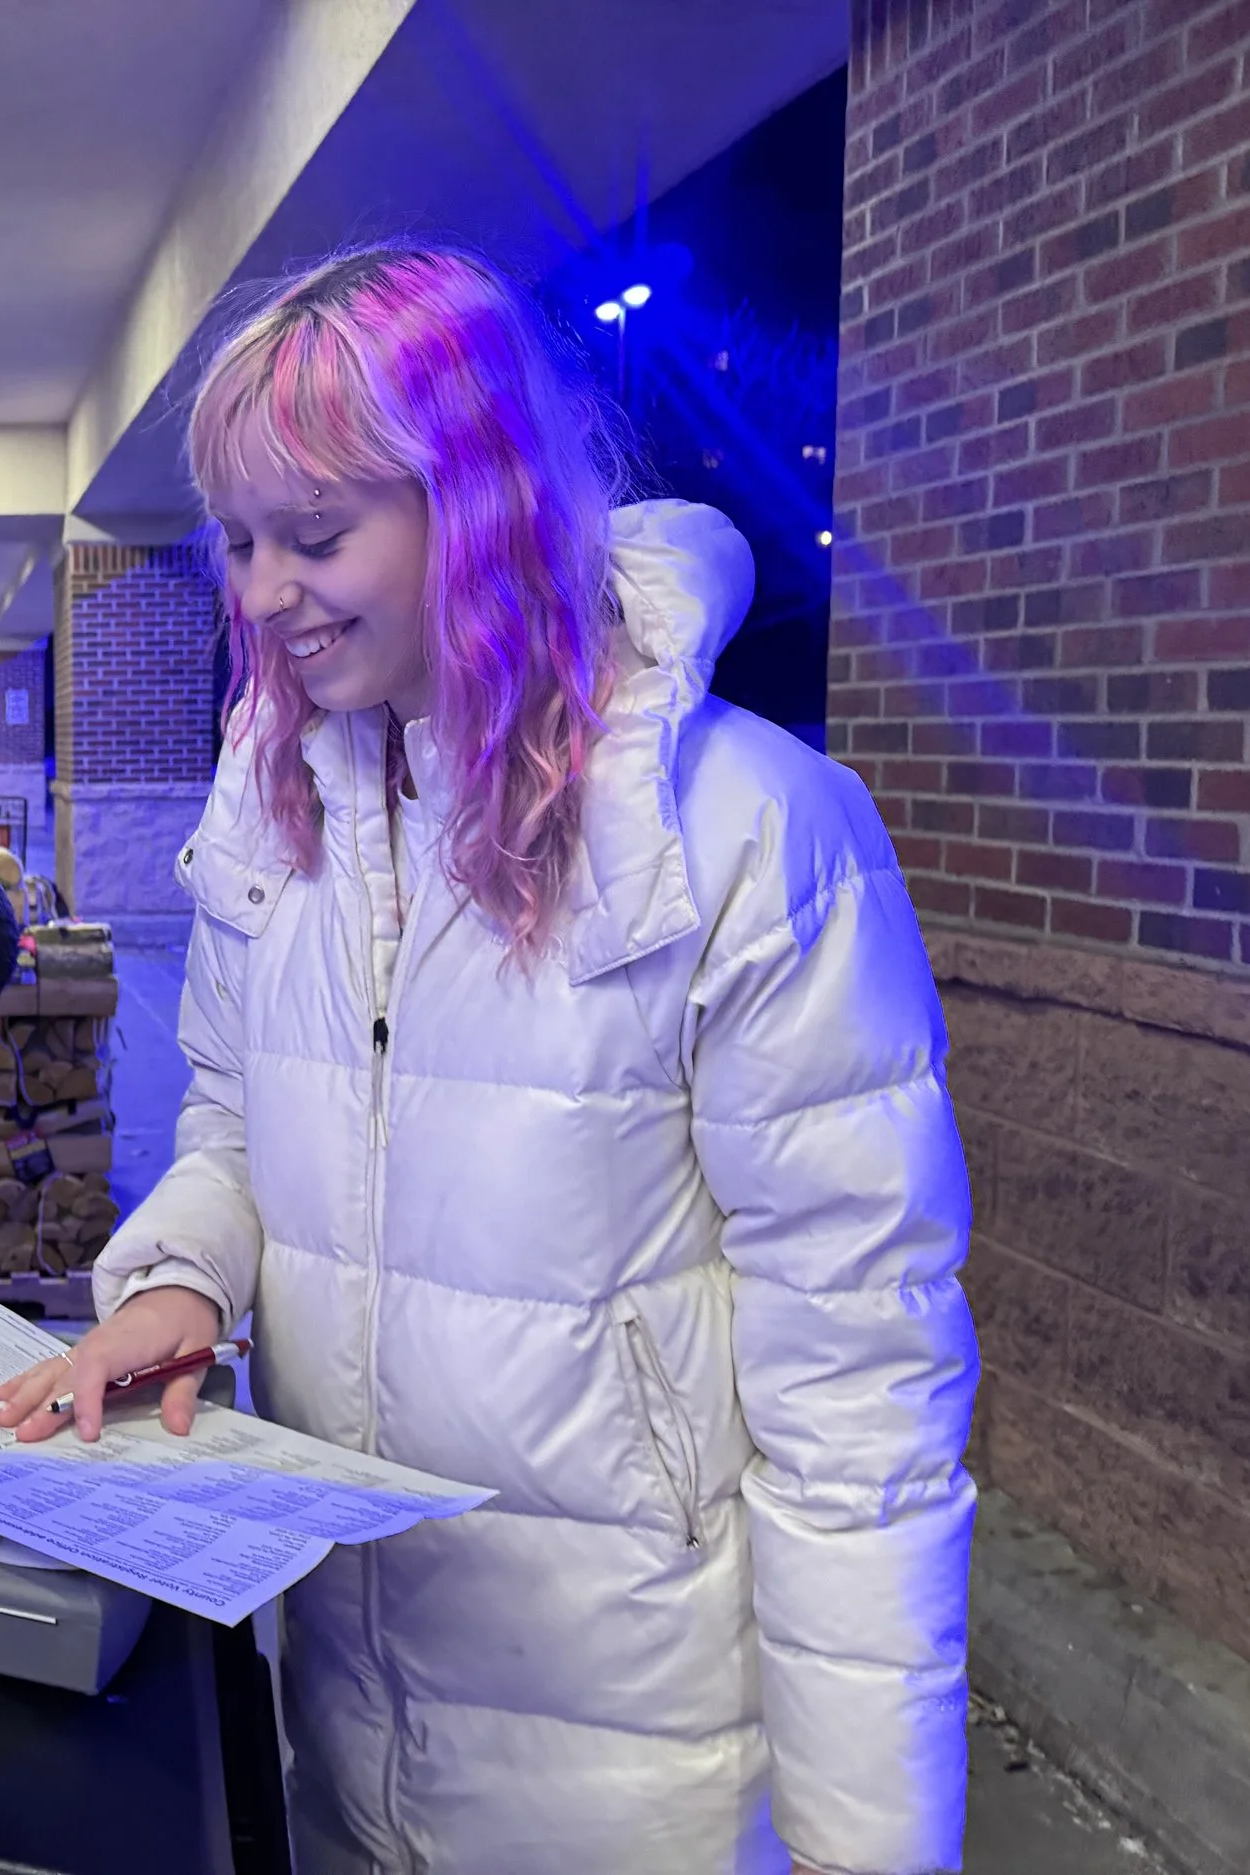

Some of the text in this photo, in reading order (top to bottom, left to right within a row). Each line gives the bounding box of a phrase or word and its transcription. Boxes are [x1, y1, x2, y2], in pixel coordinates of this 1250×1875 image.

[46, 1538, 79, 1554] Office
[79, 1552, 147, 1579] Registration
[149, 1575, 179, 1592] Voter
[182, 1588, 226, 1607] County
